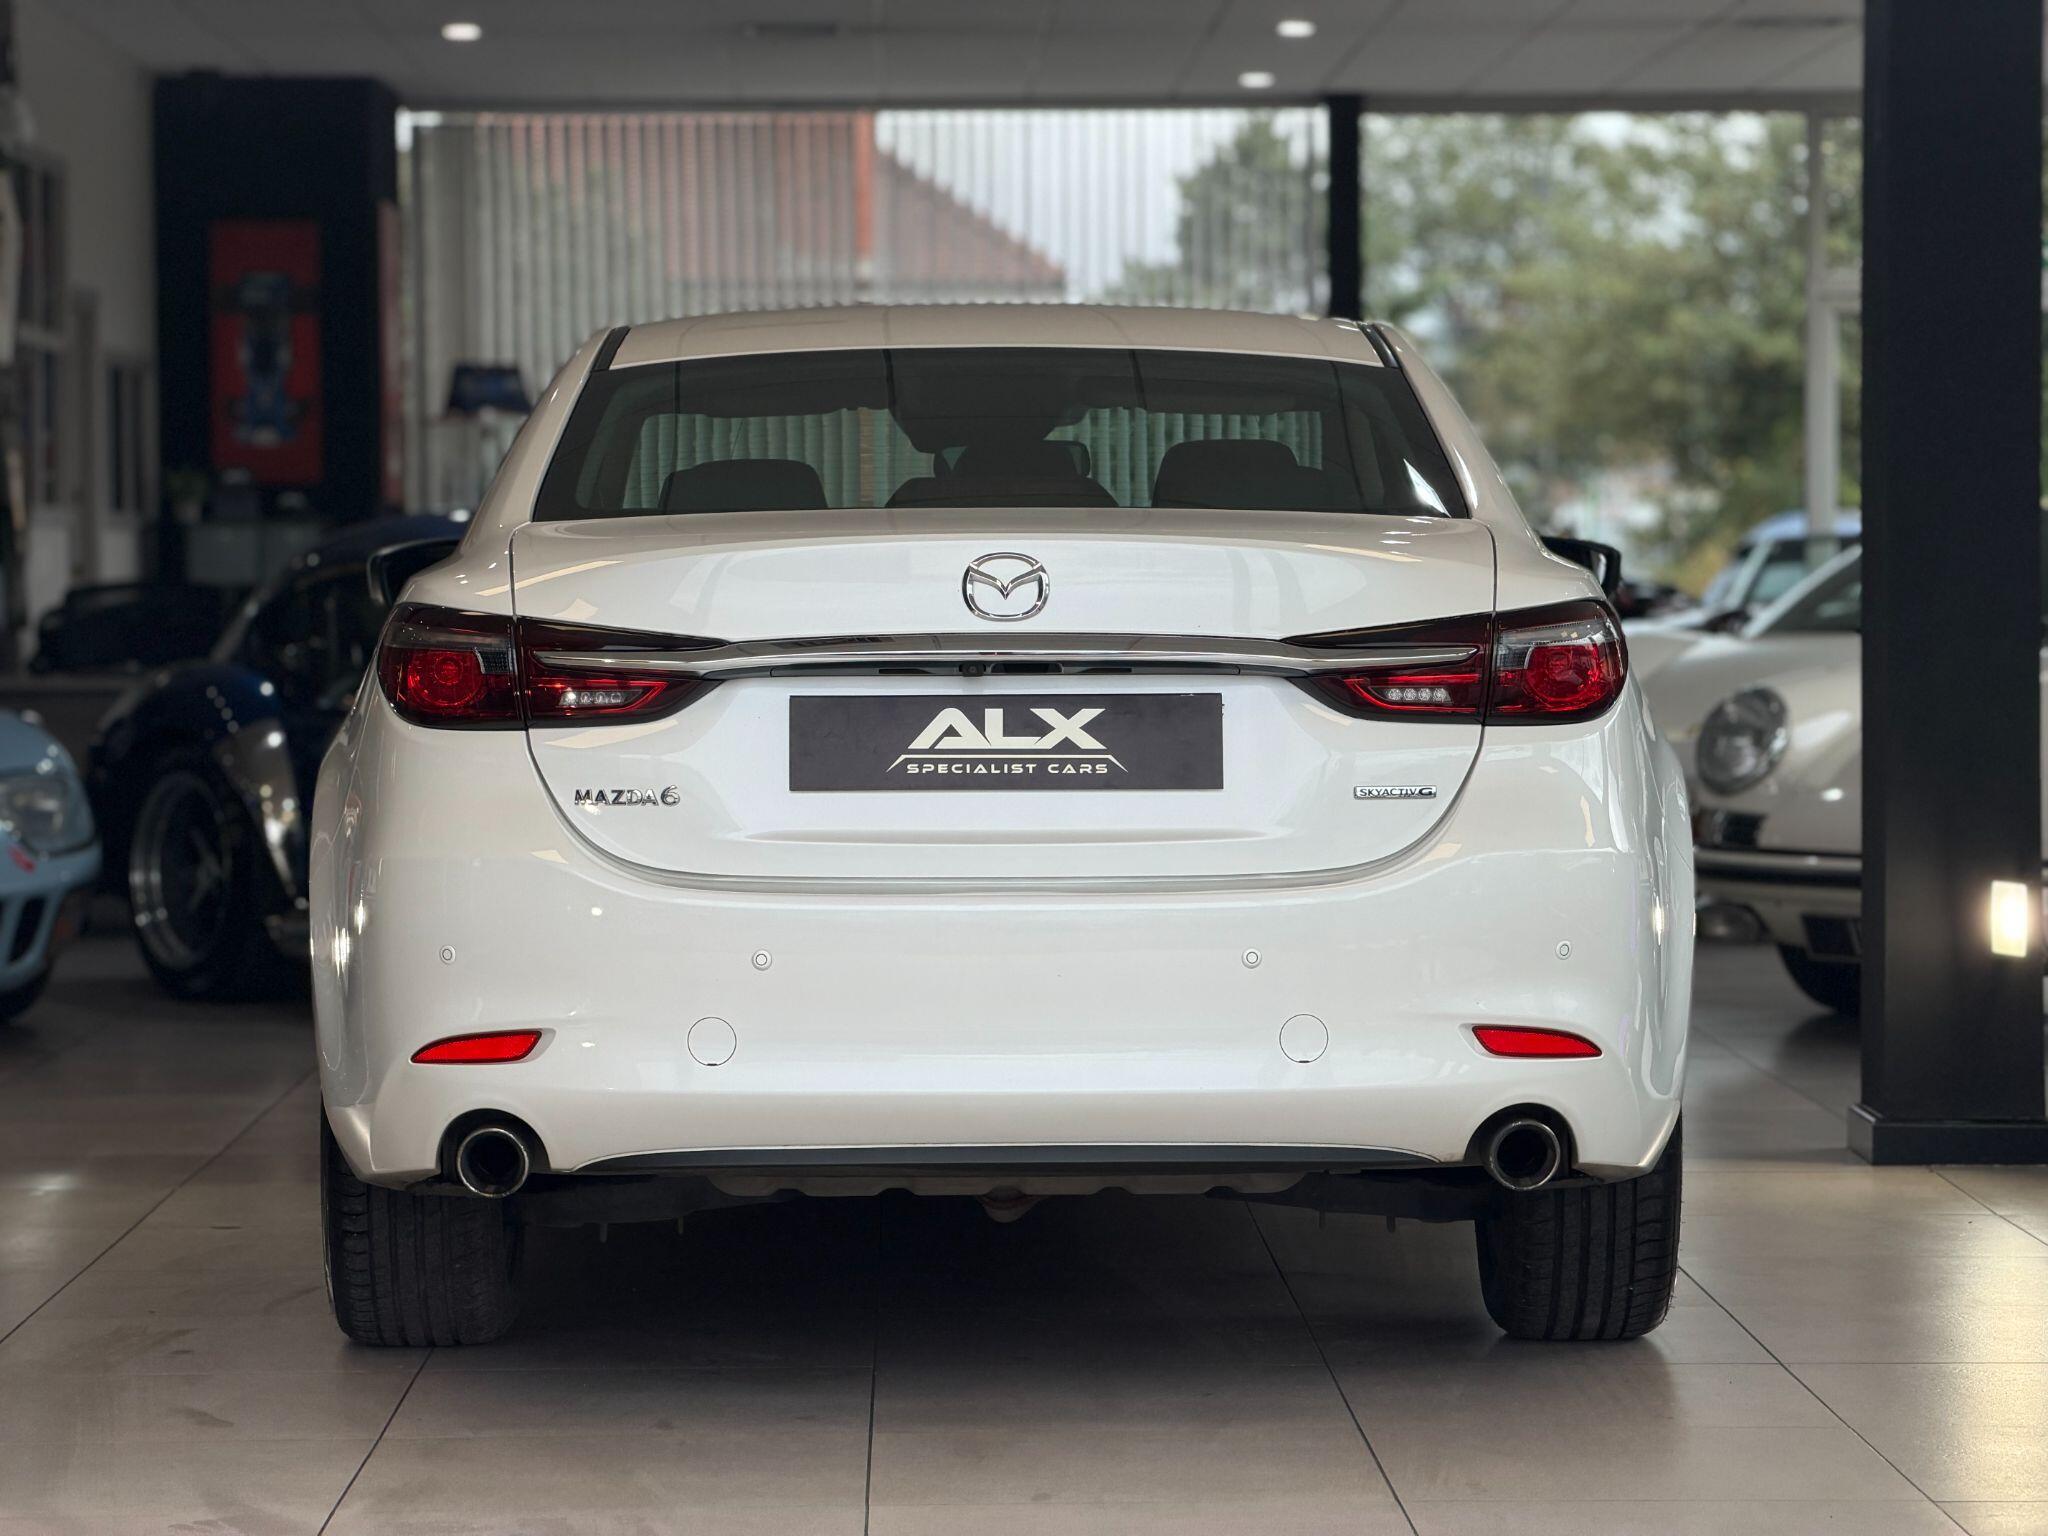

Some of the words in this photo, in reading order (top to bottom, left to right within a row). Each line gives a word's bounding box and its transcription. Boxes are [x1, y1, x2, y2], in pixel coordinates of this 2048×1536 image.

[907, 707, 1108, 750] ALX
[906, 763, 1037, 774] SPECIALIST
[1048, 763, 1108, 774] CARS
